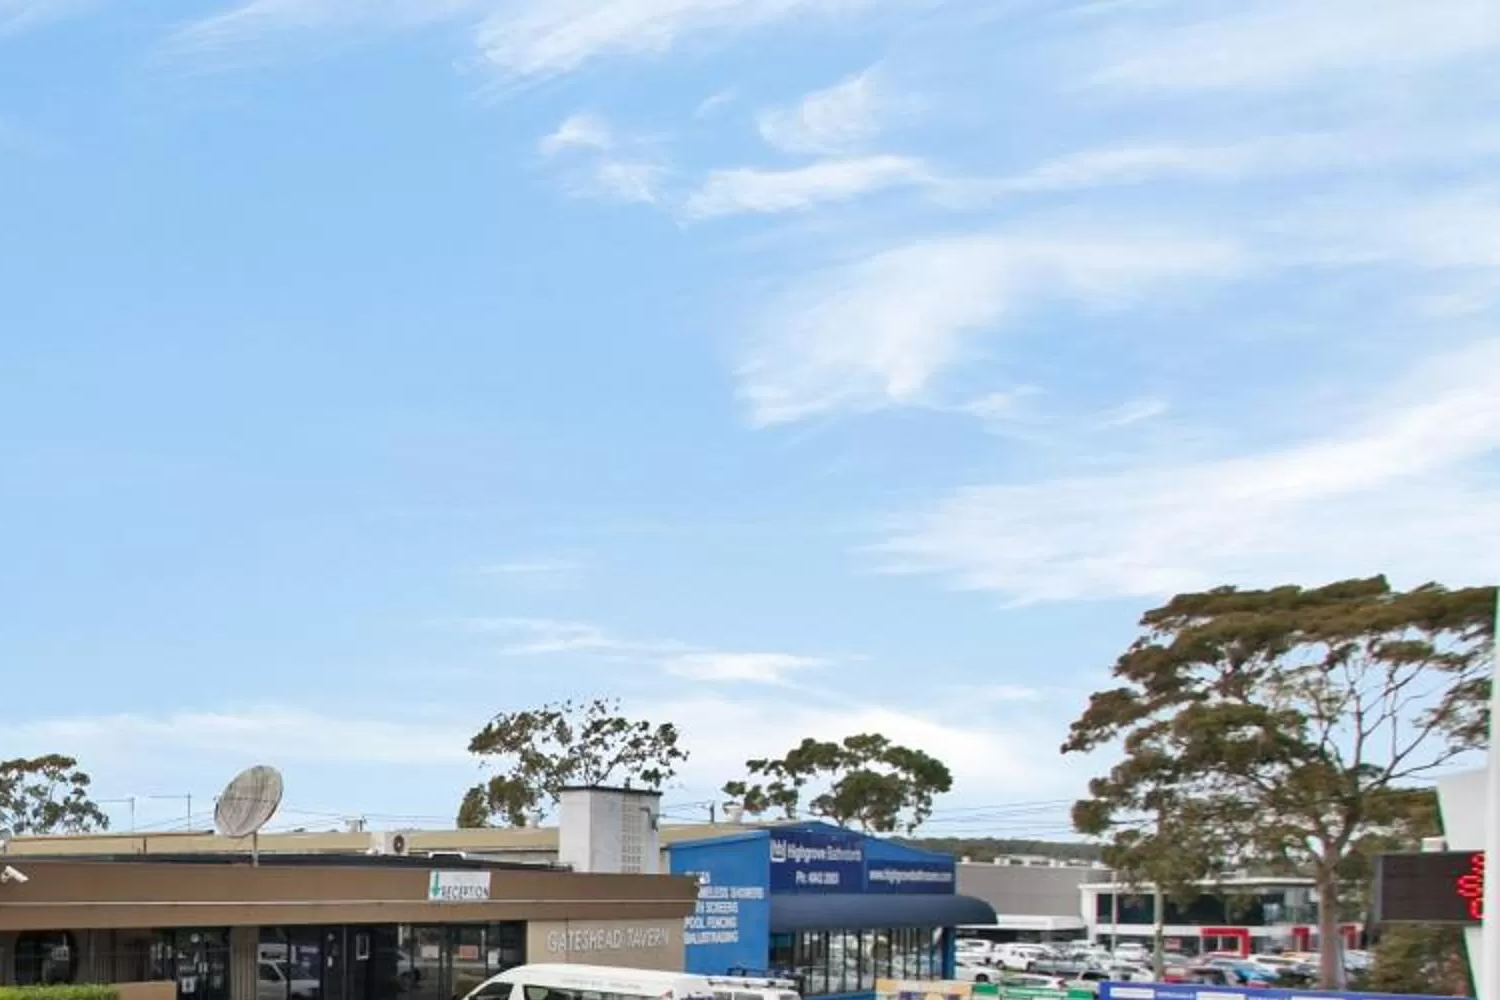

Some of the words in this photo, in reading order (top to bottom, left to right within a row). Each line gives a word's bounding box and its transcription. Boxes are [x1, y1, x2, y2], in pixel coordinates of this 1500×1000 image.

[441, 885, 490, 898] RECEPTION
[547, 928, 622, 952] GATESHEAD
[627, 927, 671, 950] TAVERN
